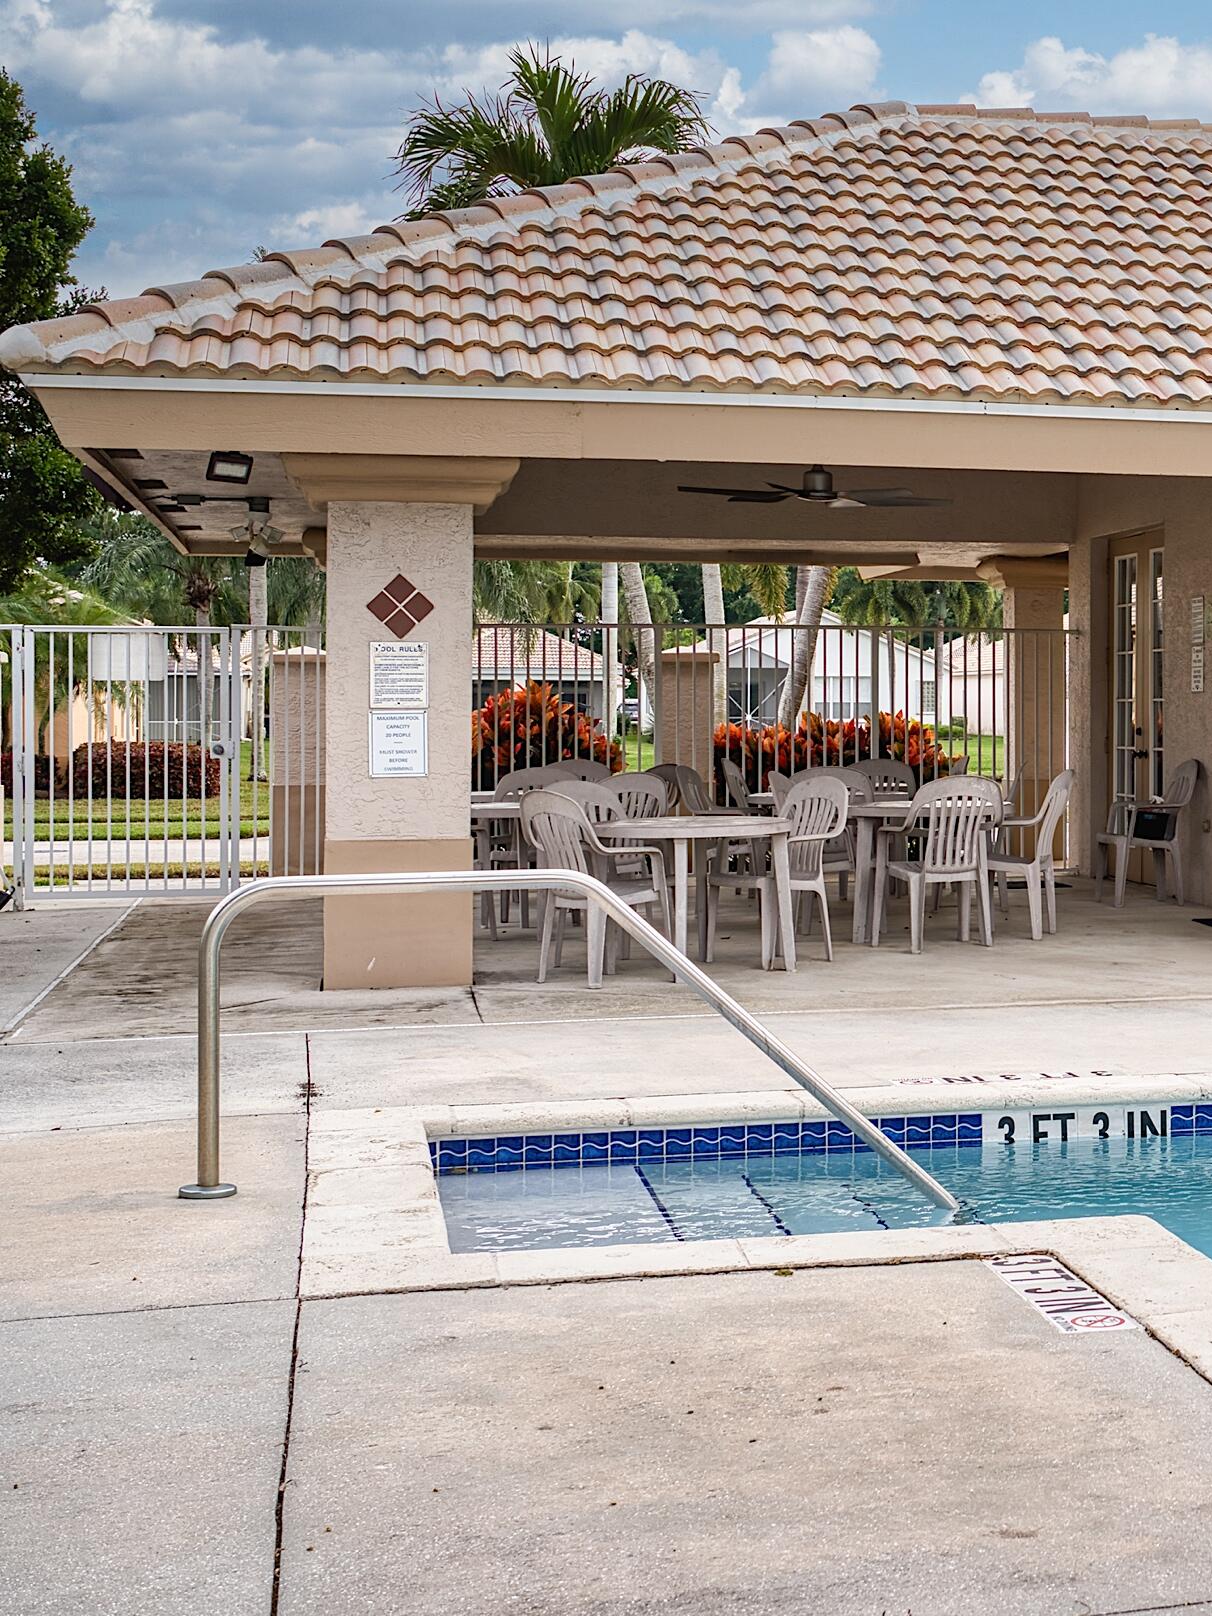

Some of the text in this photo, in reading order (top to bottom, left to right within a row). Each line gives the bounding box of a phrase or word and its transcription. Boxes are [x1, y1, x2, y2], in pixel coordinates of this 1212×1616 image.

[998, 1109, 1167, 1145] 3 FT 3 IN
[991, 1258, 1112, 1314] 3 FT 3 IN
